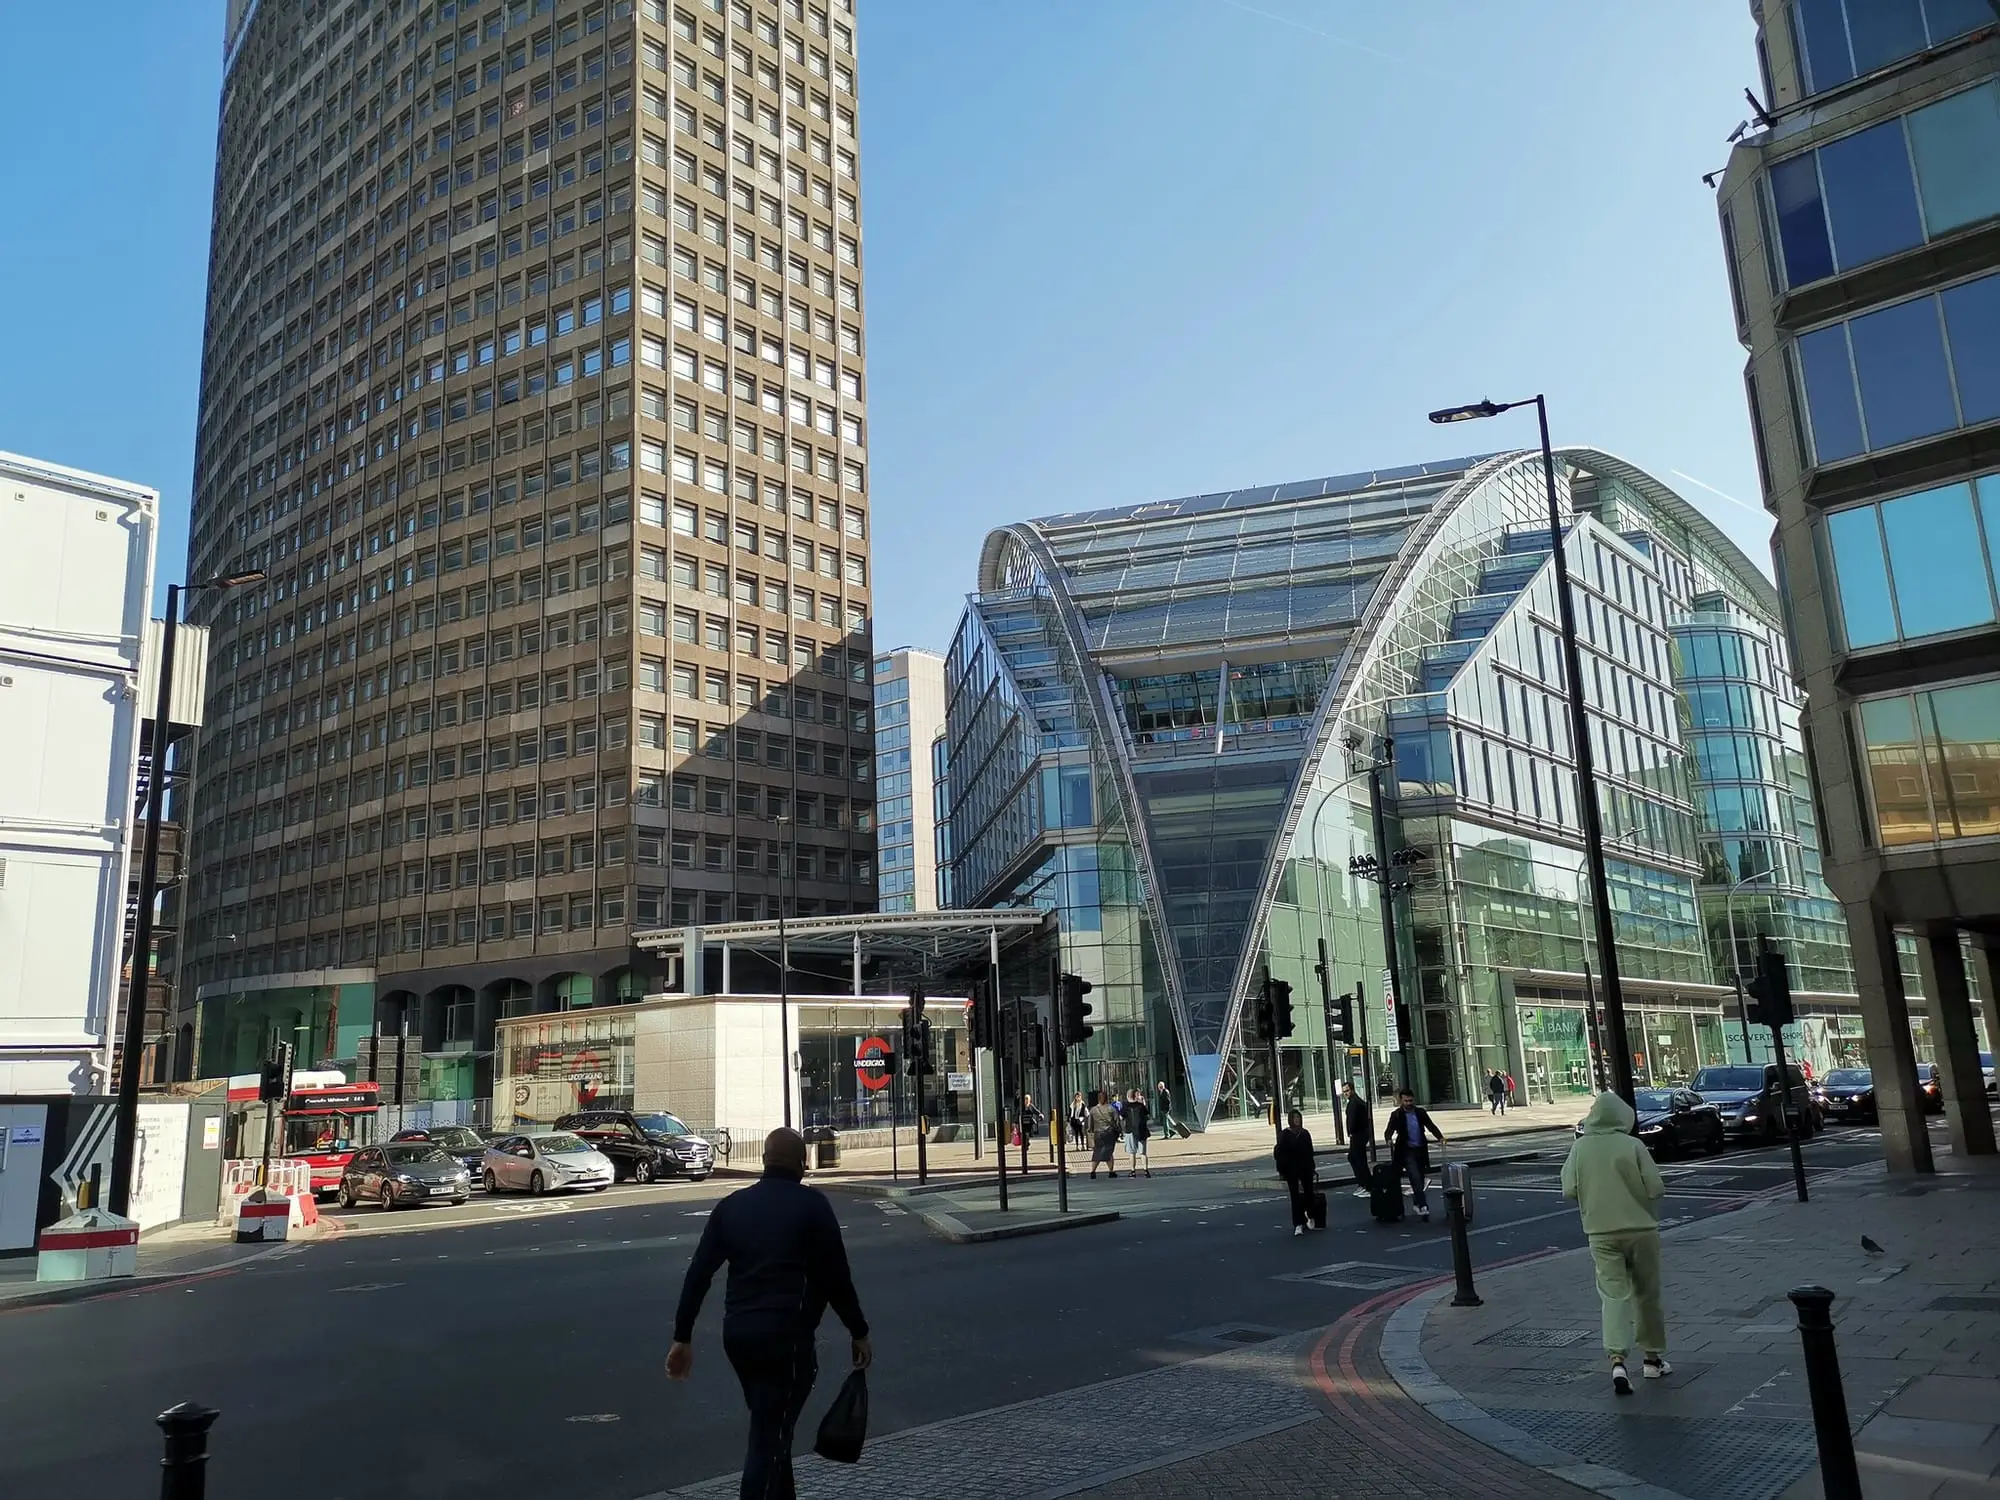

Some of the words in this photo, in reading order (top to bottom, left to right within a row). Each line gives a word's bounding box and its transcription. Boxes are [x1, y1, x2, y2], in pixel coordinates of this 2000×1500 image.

[1547, 1022, 1578, 1033] BANK
[1725, 1033, 1766, 1042] ISCOVER
[1782, 1031, 1804, 1040] SHOPS
